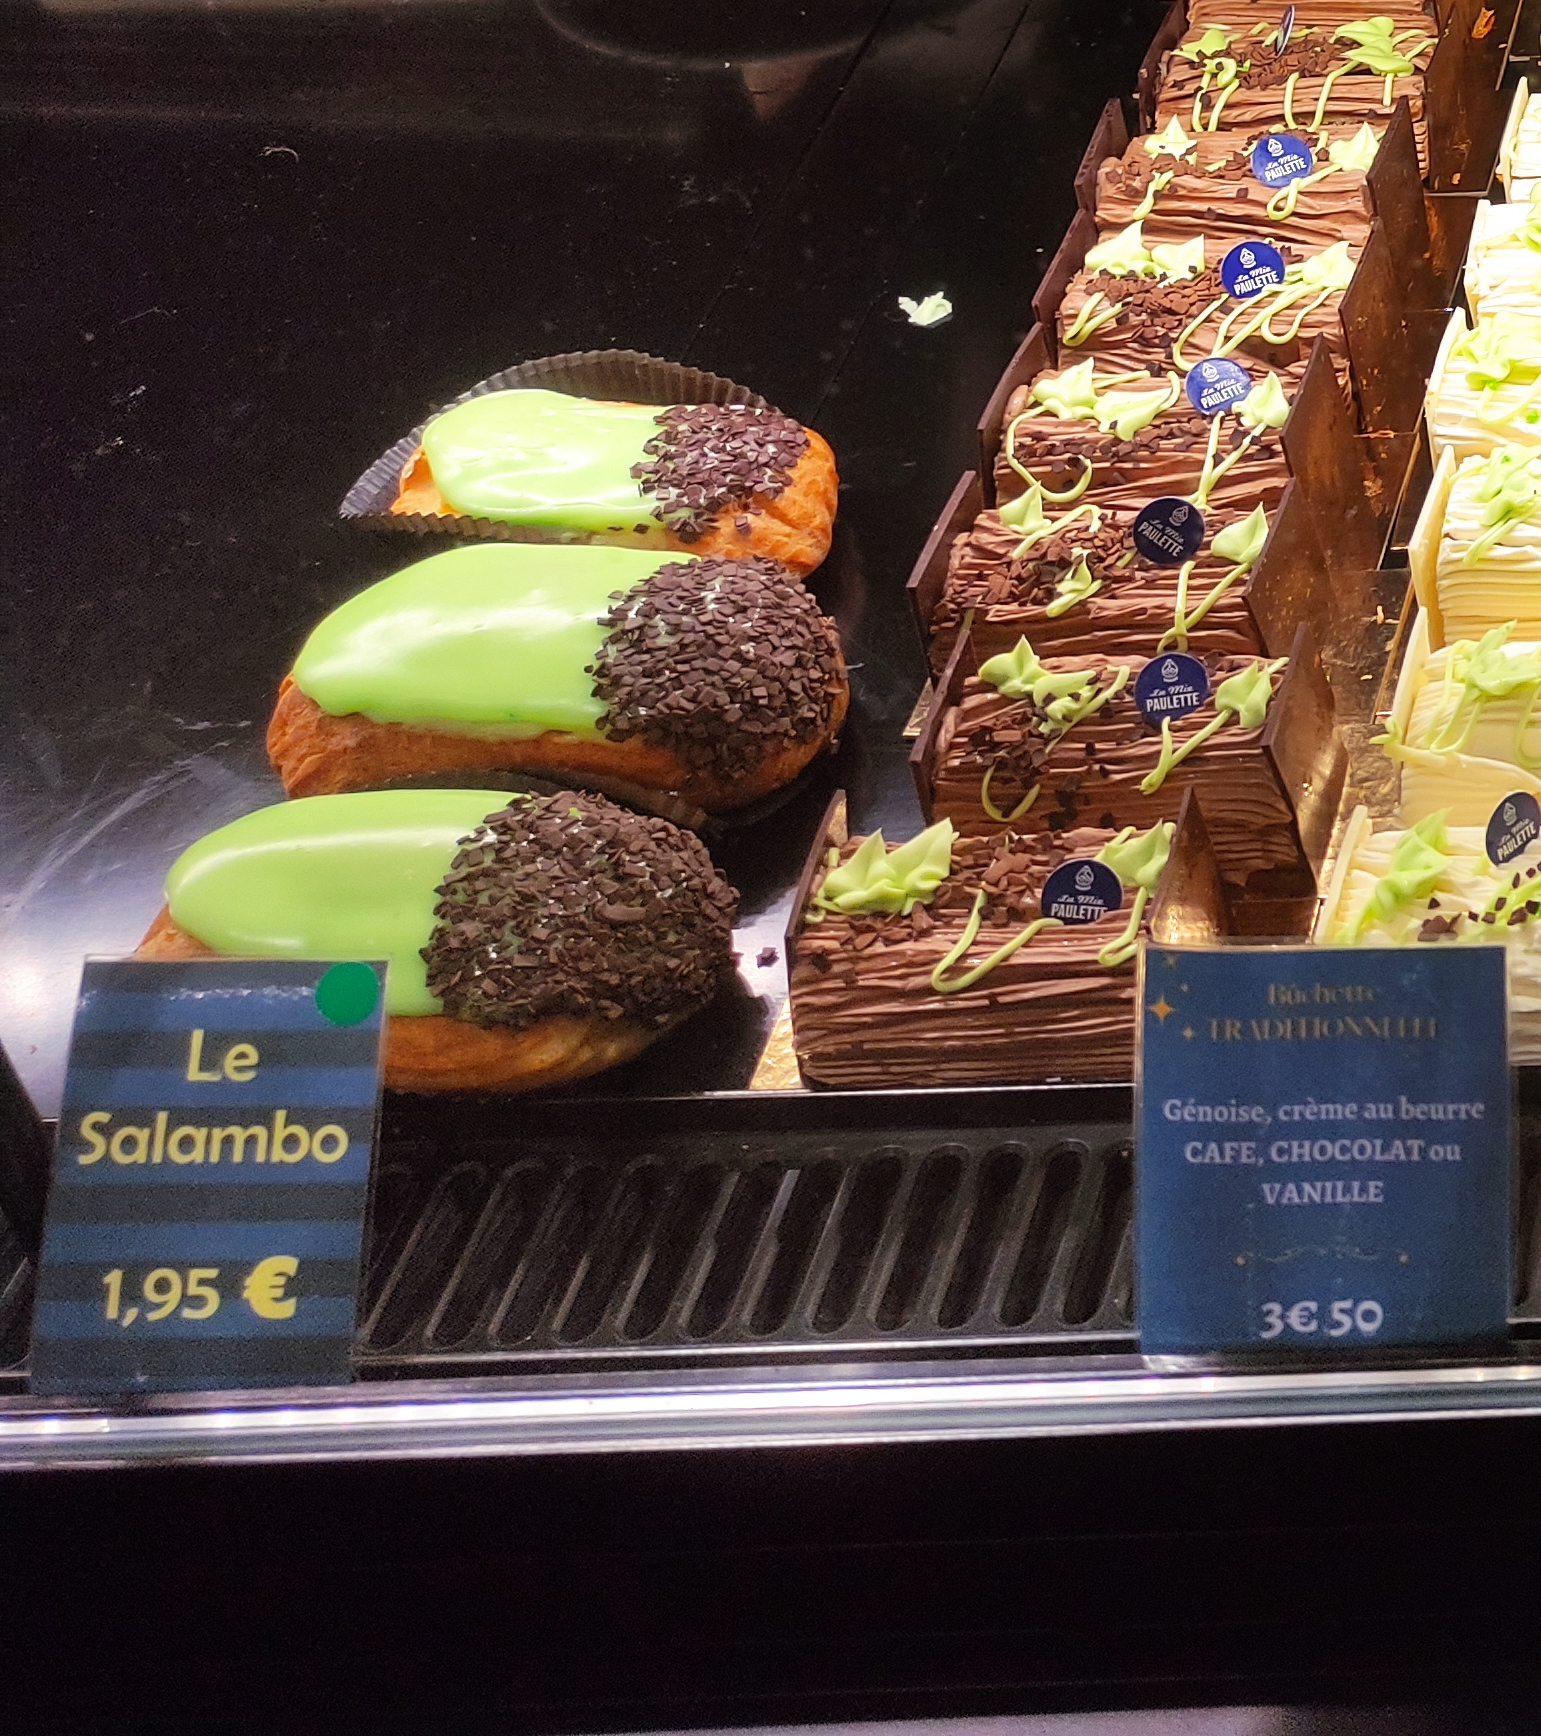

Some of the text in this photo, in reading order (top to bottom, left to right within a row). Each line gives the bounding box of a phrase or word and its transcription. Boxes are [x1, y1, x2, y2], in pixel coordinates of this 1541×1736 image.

[1264, 158, 1307, 182] PAULETTE
[1267, 154, 1299, 171] La Mie
[1234, 271, 1279, 296] PAULETTE
[1237, 266, 1271, 283] La Mie
[1200, 383, 1244, 409] PAULETTE
[1203, 379, 1236, 396] La Mie
[1138, 523, 1183, 557] PAULETTE
[1150, 519, 1184, 543] La Mie
[1146, 693, 1200, 711] PAULETTE
[1151, 686, 1193, 697] La Mie
[1497, 821, 1537, 862] PAULETTE
[187, 1028, 260, 1083] Le
[1163, 1095, 1485, 1125] Génoise, crème au beurre
[78, 1109, 350, 1164] Salambo
[1184, 1139, 1462, 1166] CAFE, CHOCOLAT ou
[1261, 1181, 1385, 1205] VANILLE
[102, 1255, 300, 1328] 1,95 €
